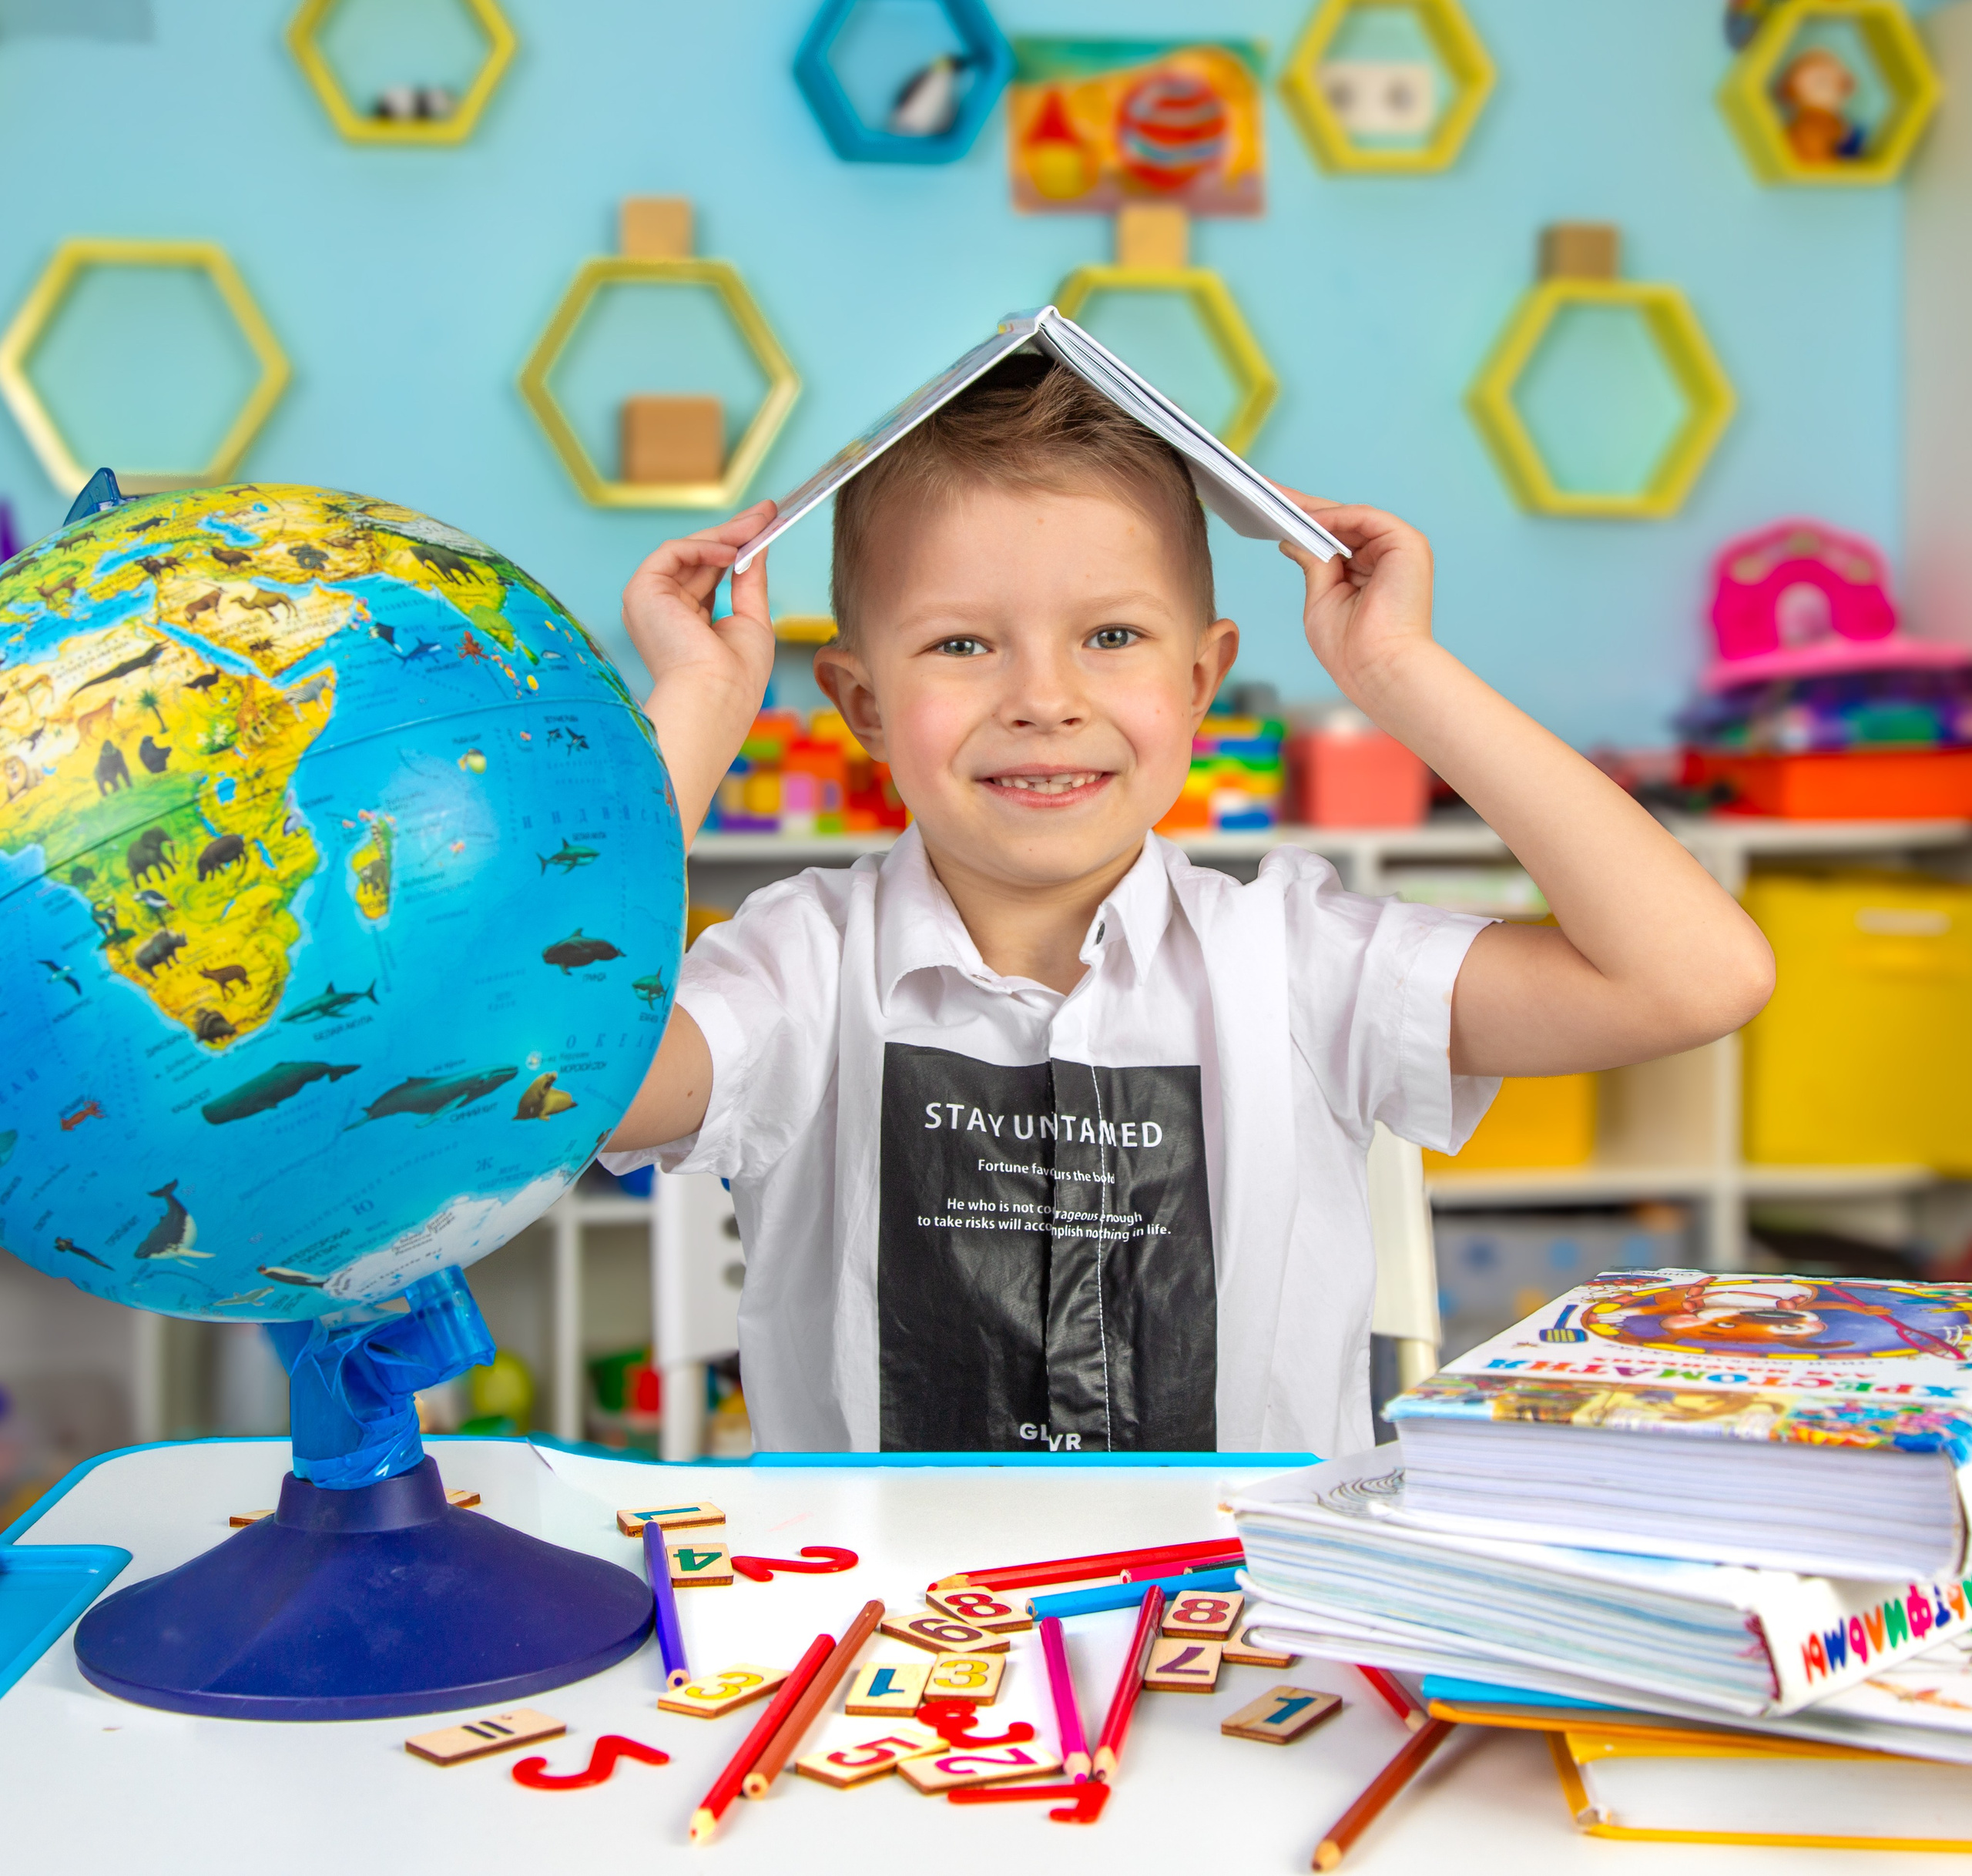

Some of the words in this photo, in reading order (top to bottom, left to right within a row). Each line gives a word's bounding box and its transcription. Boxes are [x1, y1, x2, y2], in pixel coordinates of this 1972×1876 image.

[924, 1102, 1004, 1137] STAY
[1013, 1112, 1162, 1147] UNTAMED
[978, 1159, 1028, 1174] Fortune
[1073, 1171, 1091, 1181] the
[1093, 1172, 1115, 1184] bold
[947, 1198, 964, 1210] He
[968, 1199, 996, 1211] who
[999, 1201, 1009, 1212] is
[1012, 1203, 1034, 1213] not
[1099, 1211, 1142, 1226] enough
[917, 1215, 931, 1226] to
[934, 1215, 962, 1228] take
[965, 1217, 995, 1229] risks
[998, 1218, 1021, 1230] will
[1085, 1229, 1129, 1242] nothing
[1132, 1228, 1143, 1237] in
[1147, 1224, 1171, 1235] life.
[1484, 1358, 1962, 1398] ХРЕСТОМАТИЯ
[673, 1549, 723, 1571] 4
[944, 1593, 1012, 1618] 8
[1172, 1599, 1230, 1624] 8
[934, 1660, 990, 1689] 3
[1155, 1647, 1210, 1676] 7
[685, 1671, 764, 1700] 3
[1263, 1697, 1318, 1724] 1
[827, 1736, 923, 1767] 5
[934, 1748, 1039, 1774] 2
